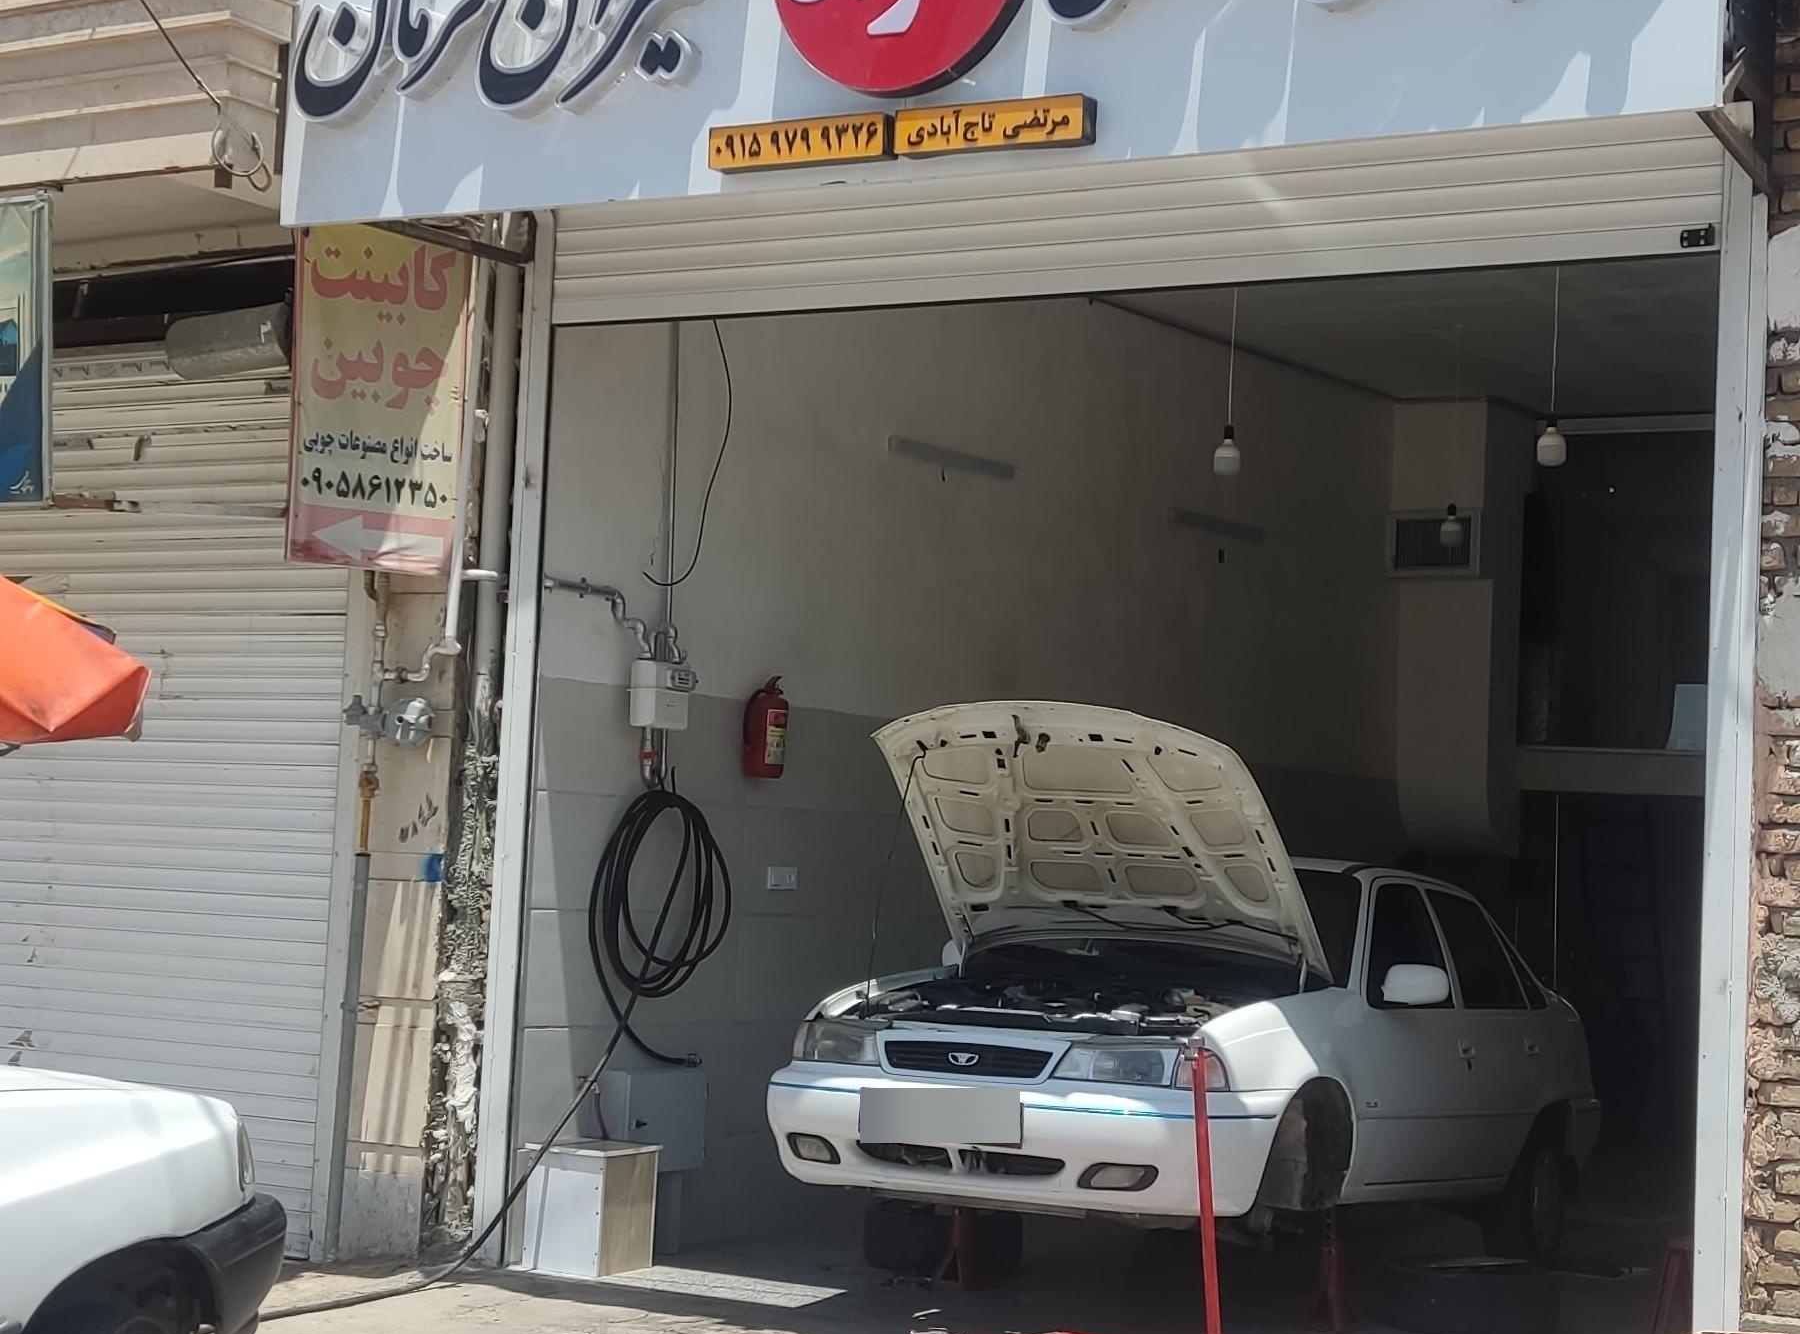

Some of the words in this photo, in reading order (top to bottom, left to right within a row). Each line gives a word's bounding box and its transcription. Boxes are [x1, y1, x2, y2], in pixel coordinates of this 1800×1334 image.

[1002, 109, 1070, 140] مرتضی
[715, 132, 761, 160] ۰۹۱۵
[770, 127, 811, 156] ۹۷۹
[820, 121, 878, 152] ۹۳۲۶
[311, 244, 457, 325] کابینت
[310, 337, 448, 416] چوبین
[303, 431, 335, 457] چوبی
[338, 429, 387, 460] مصنوعات
[390, 435, 418, 465] انواع
[420, 440, 453, 463] ساخت
[301, 466, 447, 509] ۰۹۰۵۸۶۱۲۳۵۰
